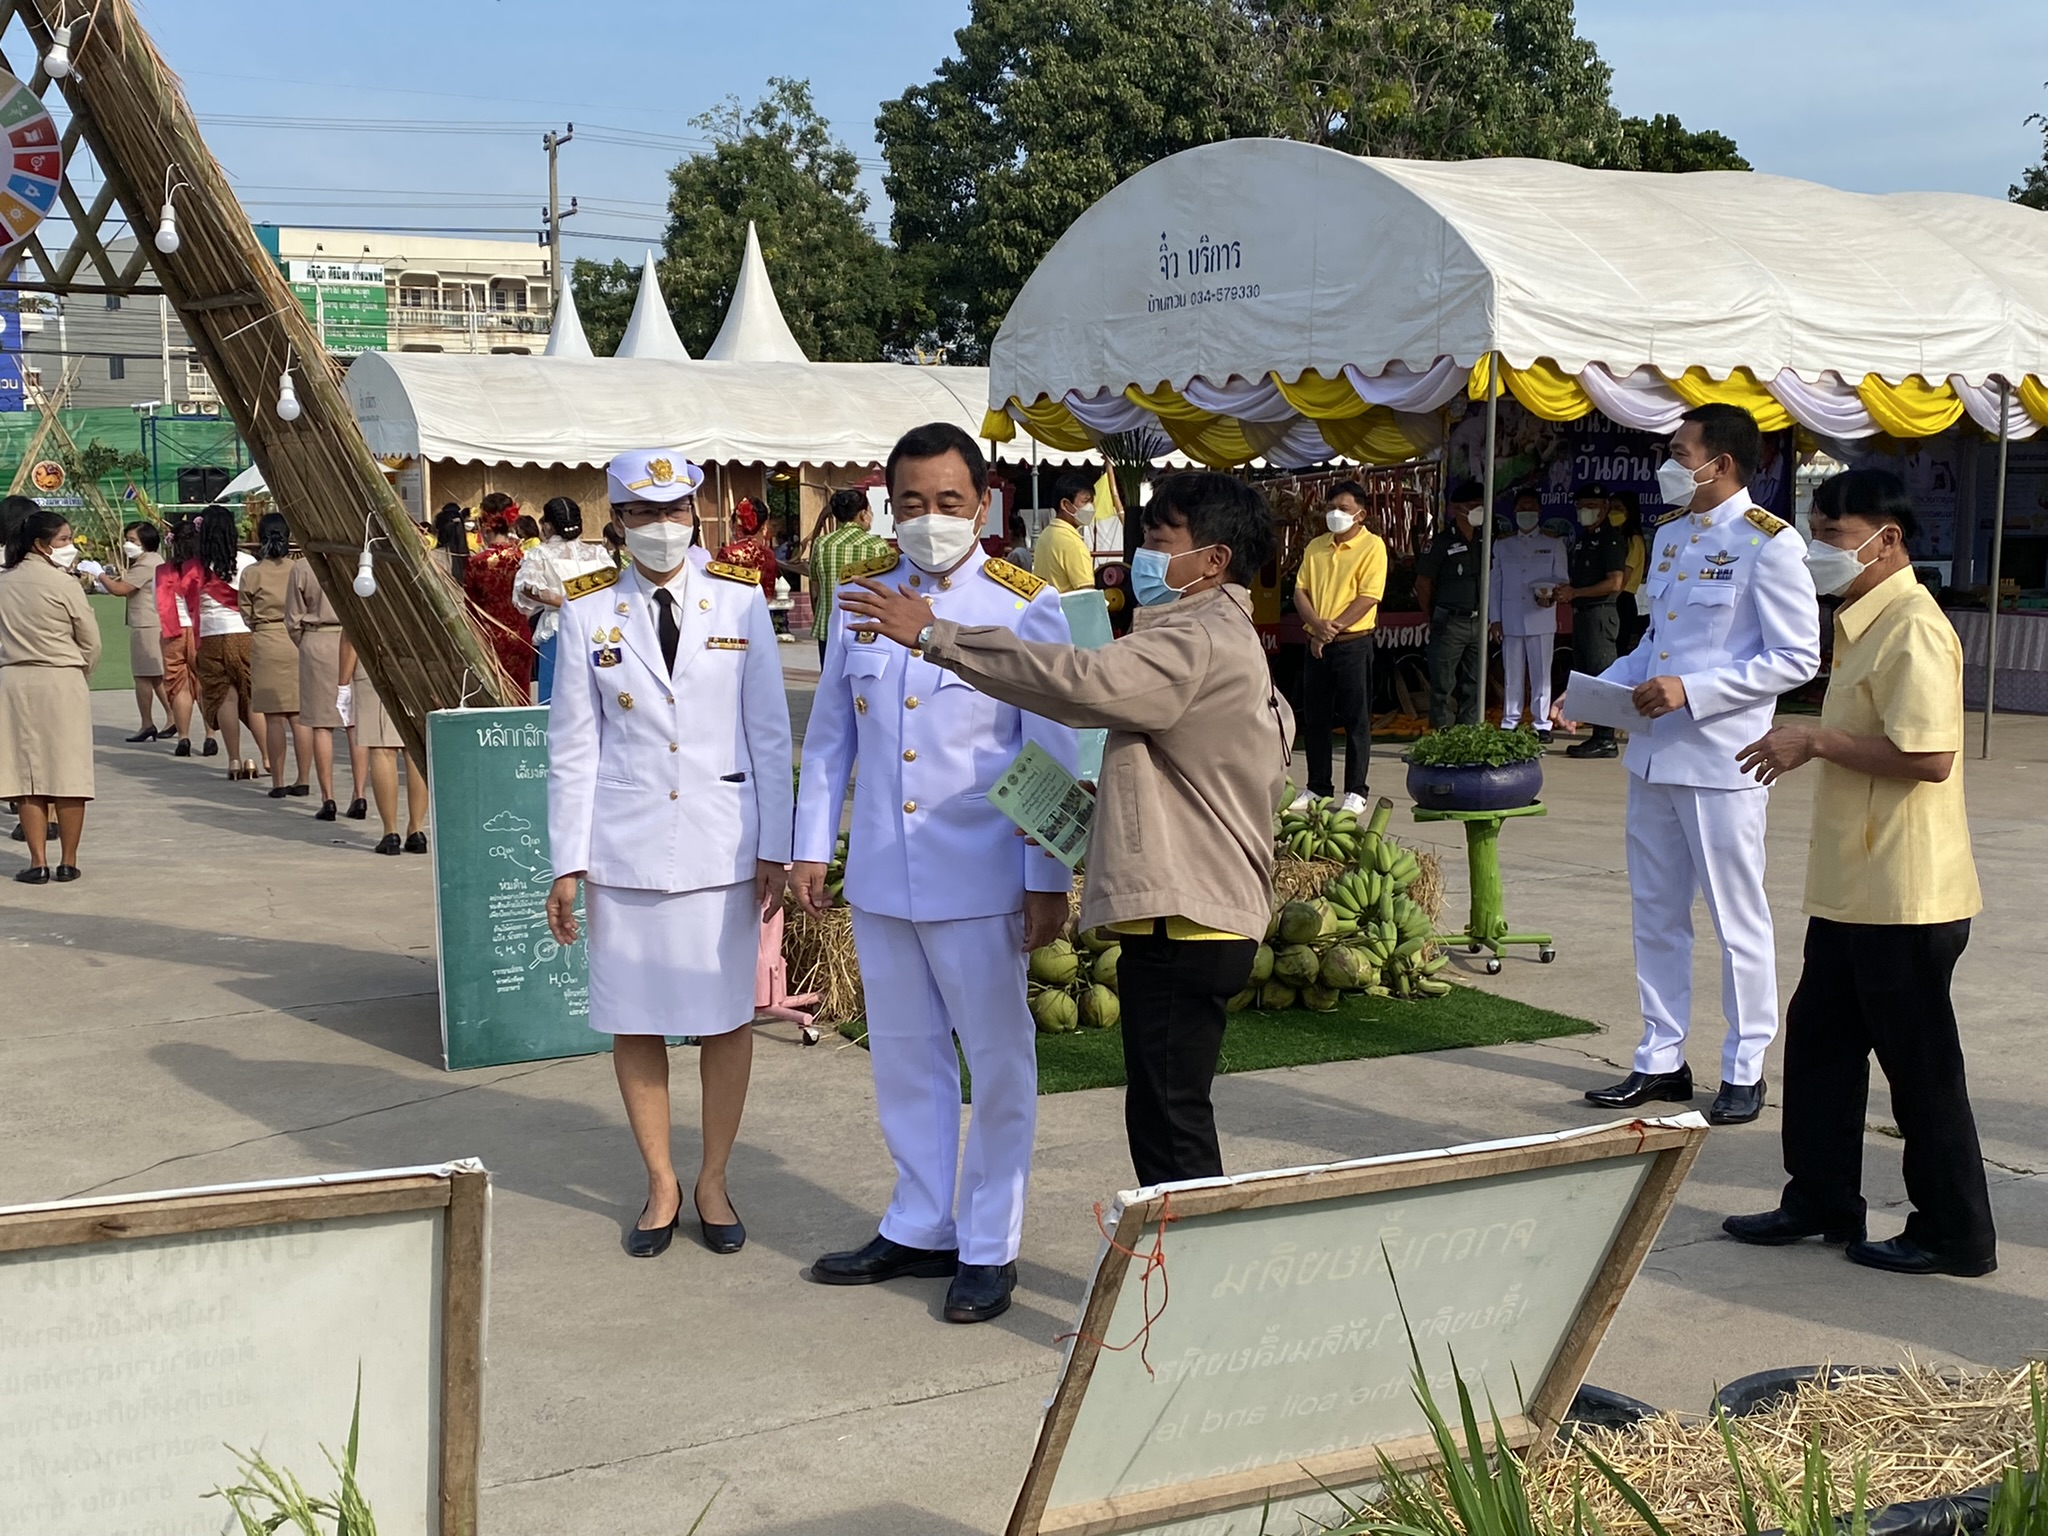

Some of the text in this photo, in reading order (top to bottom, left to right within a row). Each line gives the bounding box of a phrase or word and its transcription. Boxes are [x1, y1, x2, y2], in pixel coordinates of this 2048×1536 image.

[1188, 234, 1241, 275] บริการ
[1190, 284, 1261, 306] 034-579330
[1576, 443, 1665, 481] วันดินโ
[476, 722, 548, 747] หลักกสิก
[515, 759, 549, 779] เลี้ยงดิ
